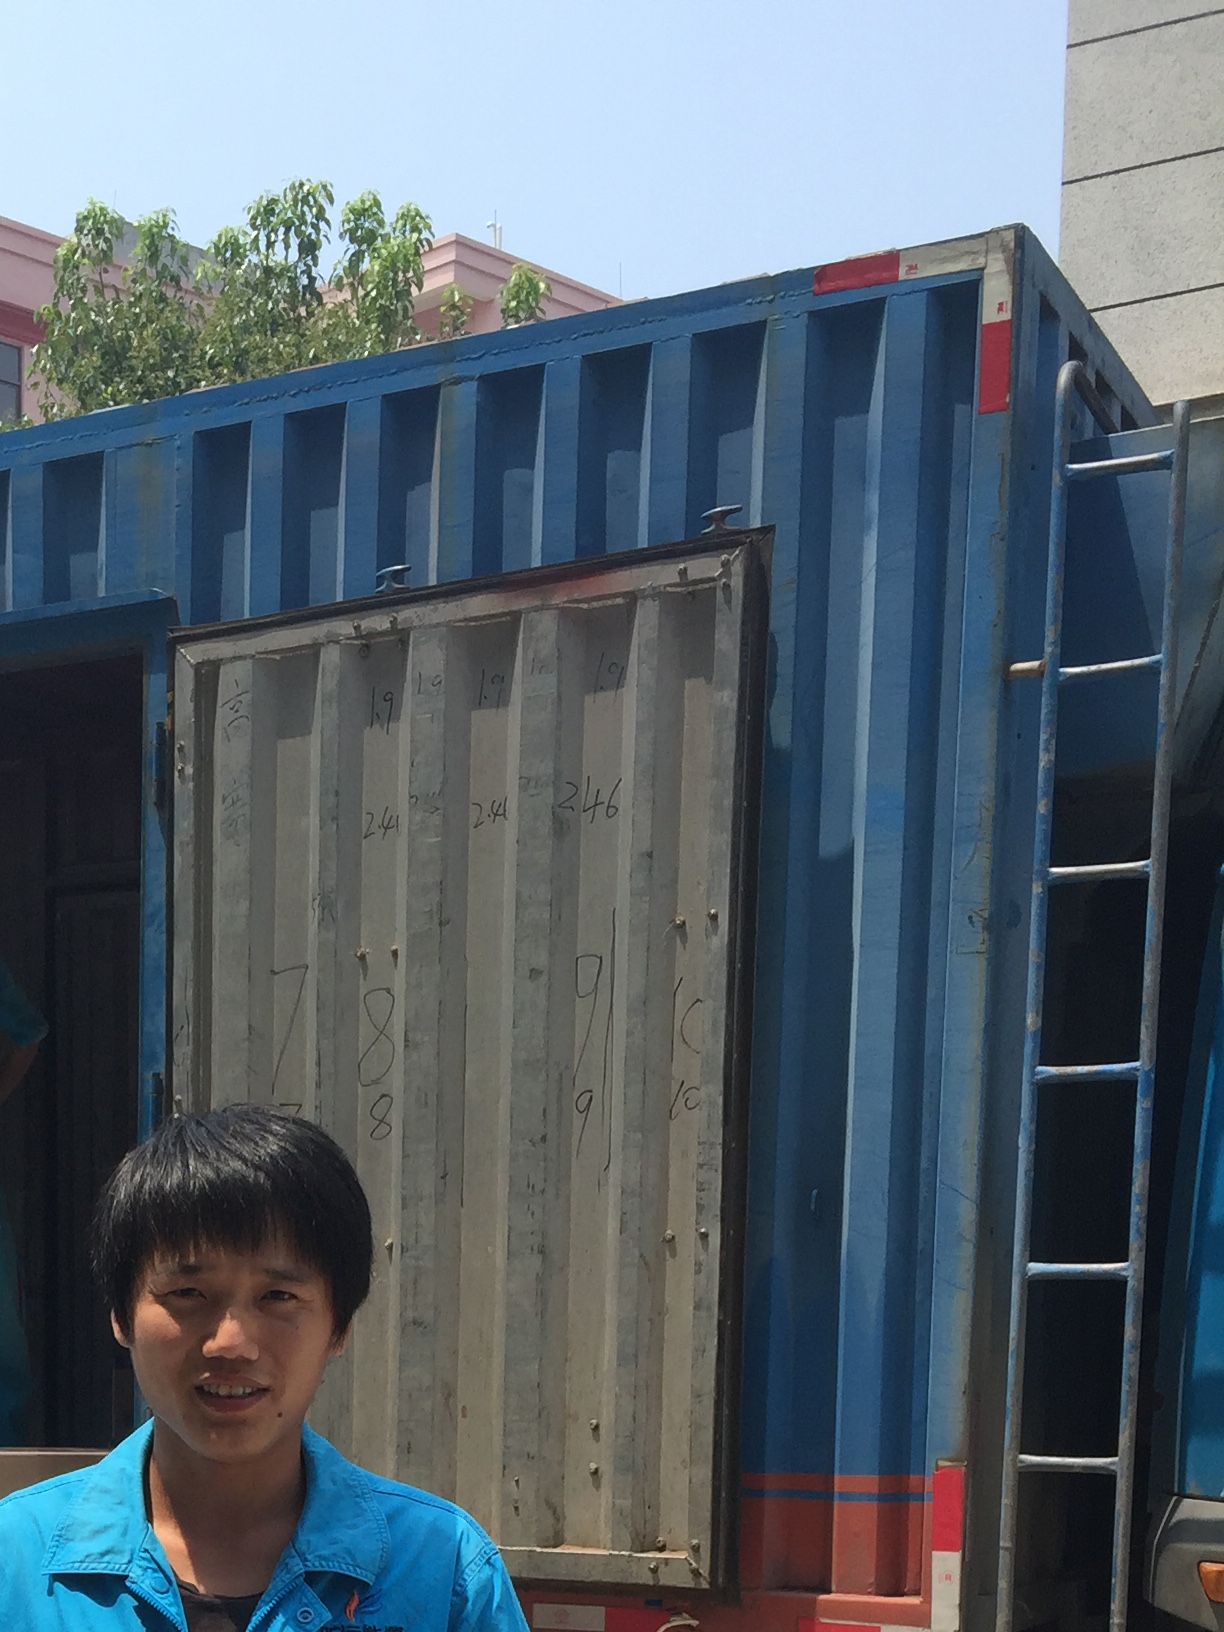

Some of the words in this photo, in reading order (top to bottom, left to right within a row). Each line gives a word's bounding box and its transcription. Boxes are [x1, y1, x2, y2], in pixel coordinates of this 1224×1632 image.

[269, 963, 309, 1096] 7
[357, 987, 396, 1088] 8
[369, 1093, 394, 1141] 8
[575, 1089, 594, 1158] 9
